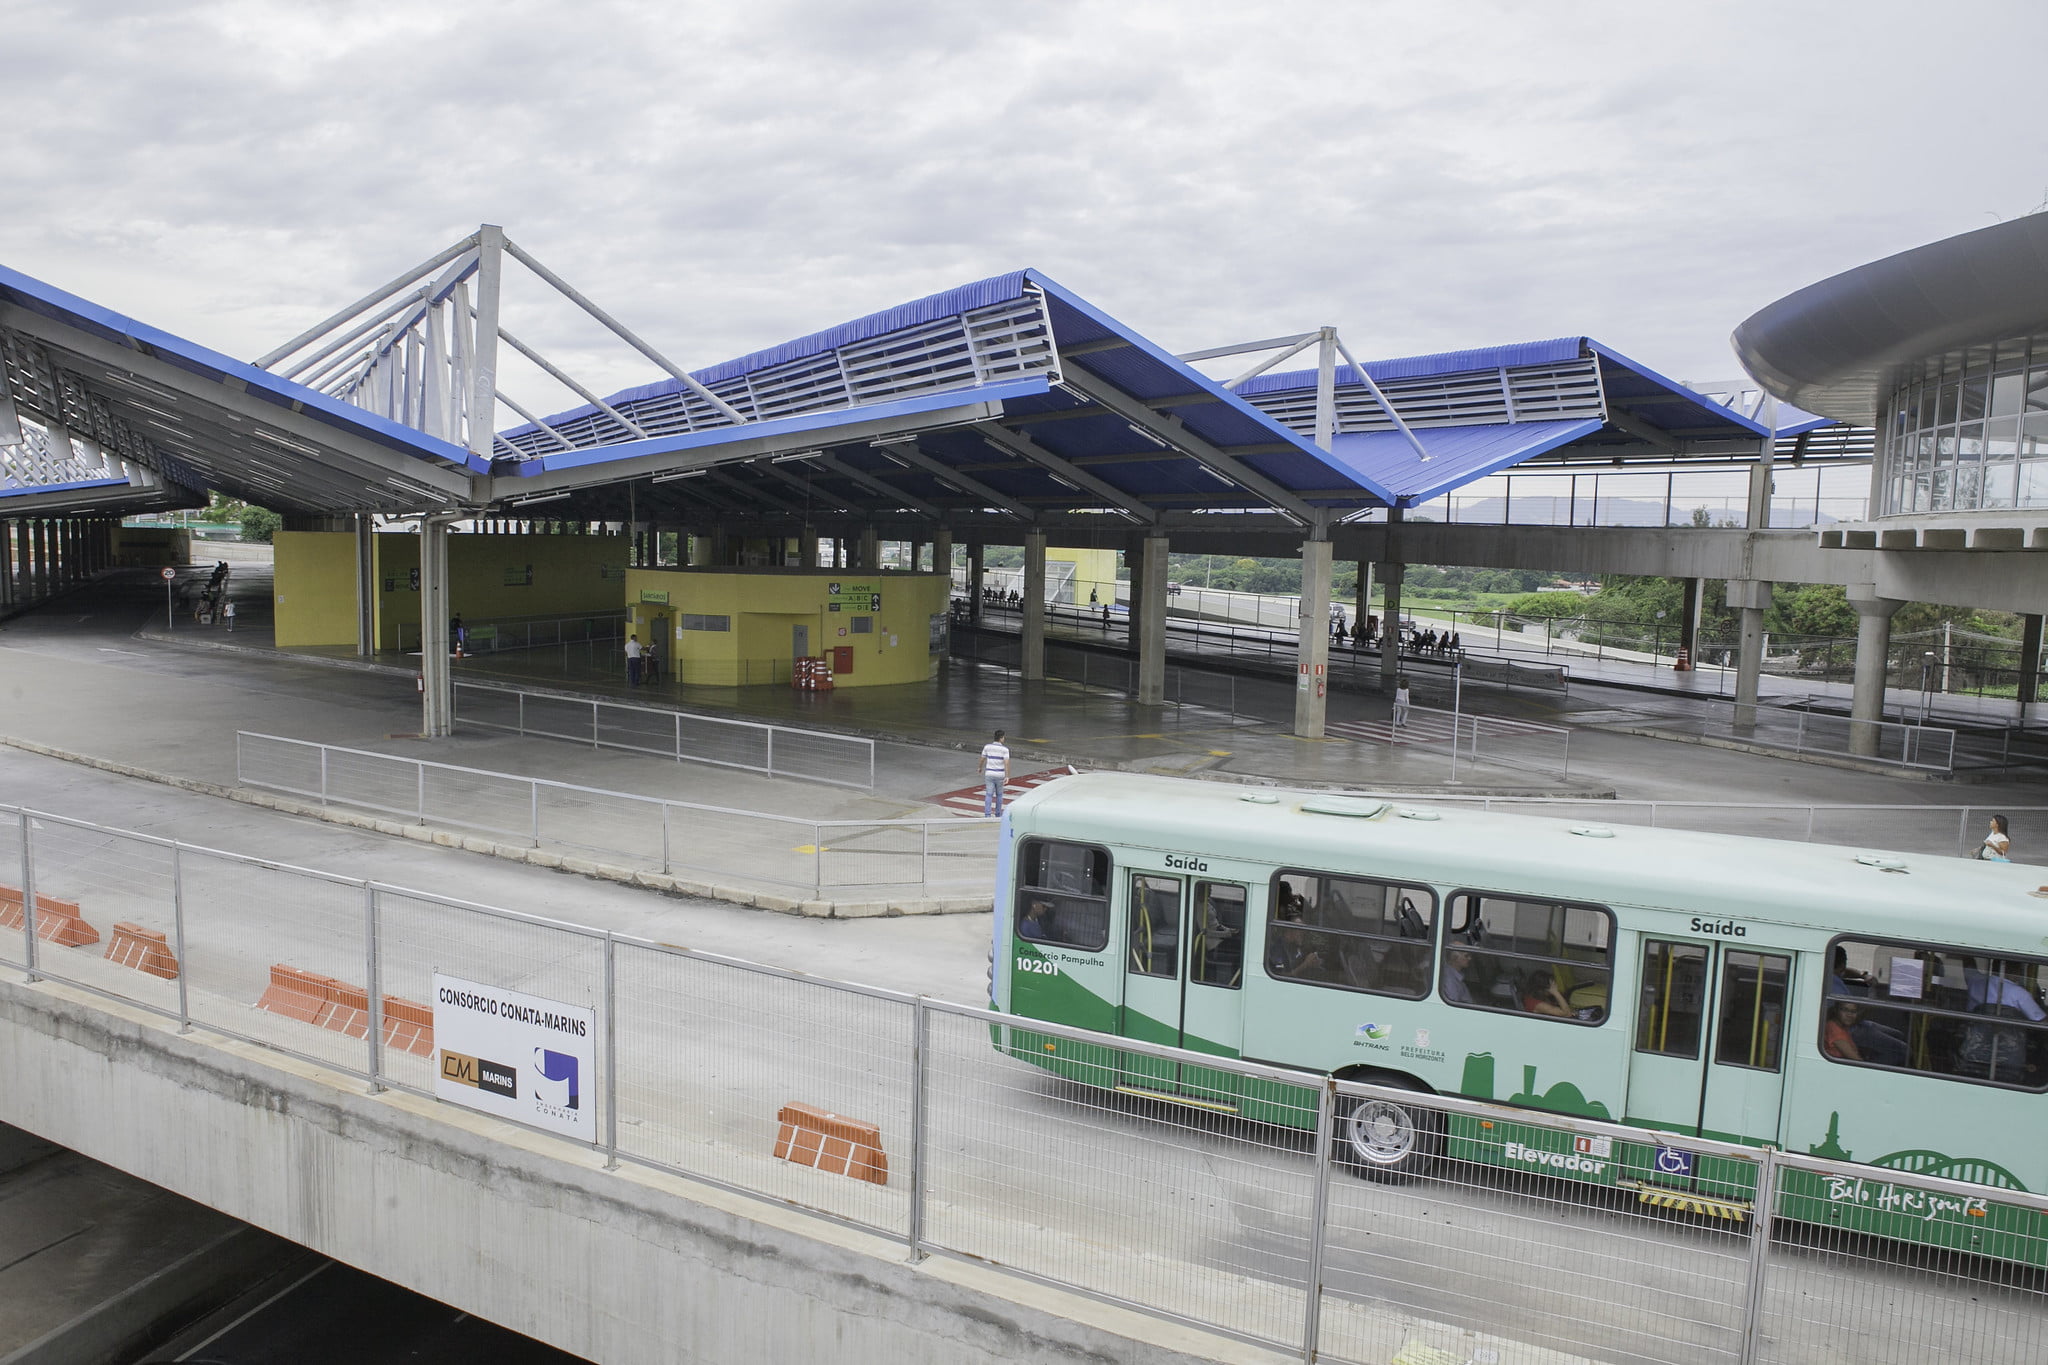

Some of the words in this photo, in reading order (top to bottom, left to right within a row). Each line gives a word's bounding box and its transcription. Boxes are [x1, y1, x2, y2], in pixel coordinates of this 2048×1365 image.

[1387, 600, 1395, 609] D
[1165, 854, 1208, 872] Saída
[1690, 917, 1746, 937] Saída
[1016, 956, 1059, 976] 10201
[1061, 953, 1104, 967] Pampulha
[439, 987, 497, 1015] CONSÓRCIO
[500, 1001, 586, 1037] CONATA-MARINS
[1353, 1040, 1390, 1052] BHTRANS
[1400, 1045, 1445, 1057] PREFEITURA
[1400, 1050, 1415, 1058] BELO
[1415, 1053, 1445, 1063] HORIZONTE
[482, 1070, 513, 1088] MARINS
[536, 1106, 577, 1122] CONATA
[1504, 1141, 1606, 1174] Elevador
[1822, 1173, 1869, 1203] Belo
